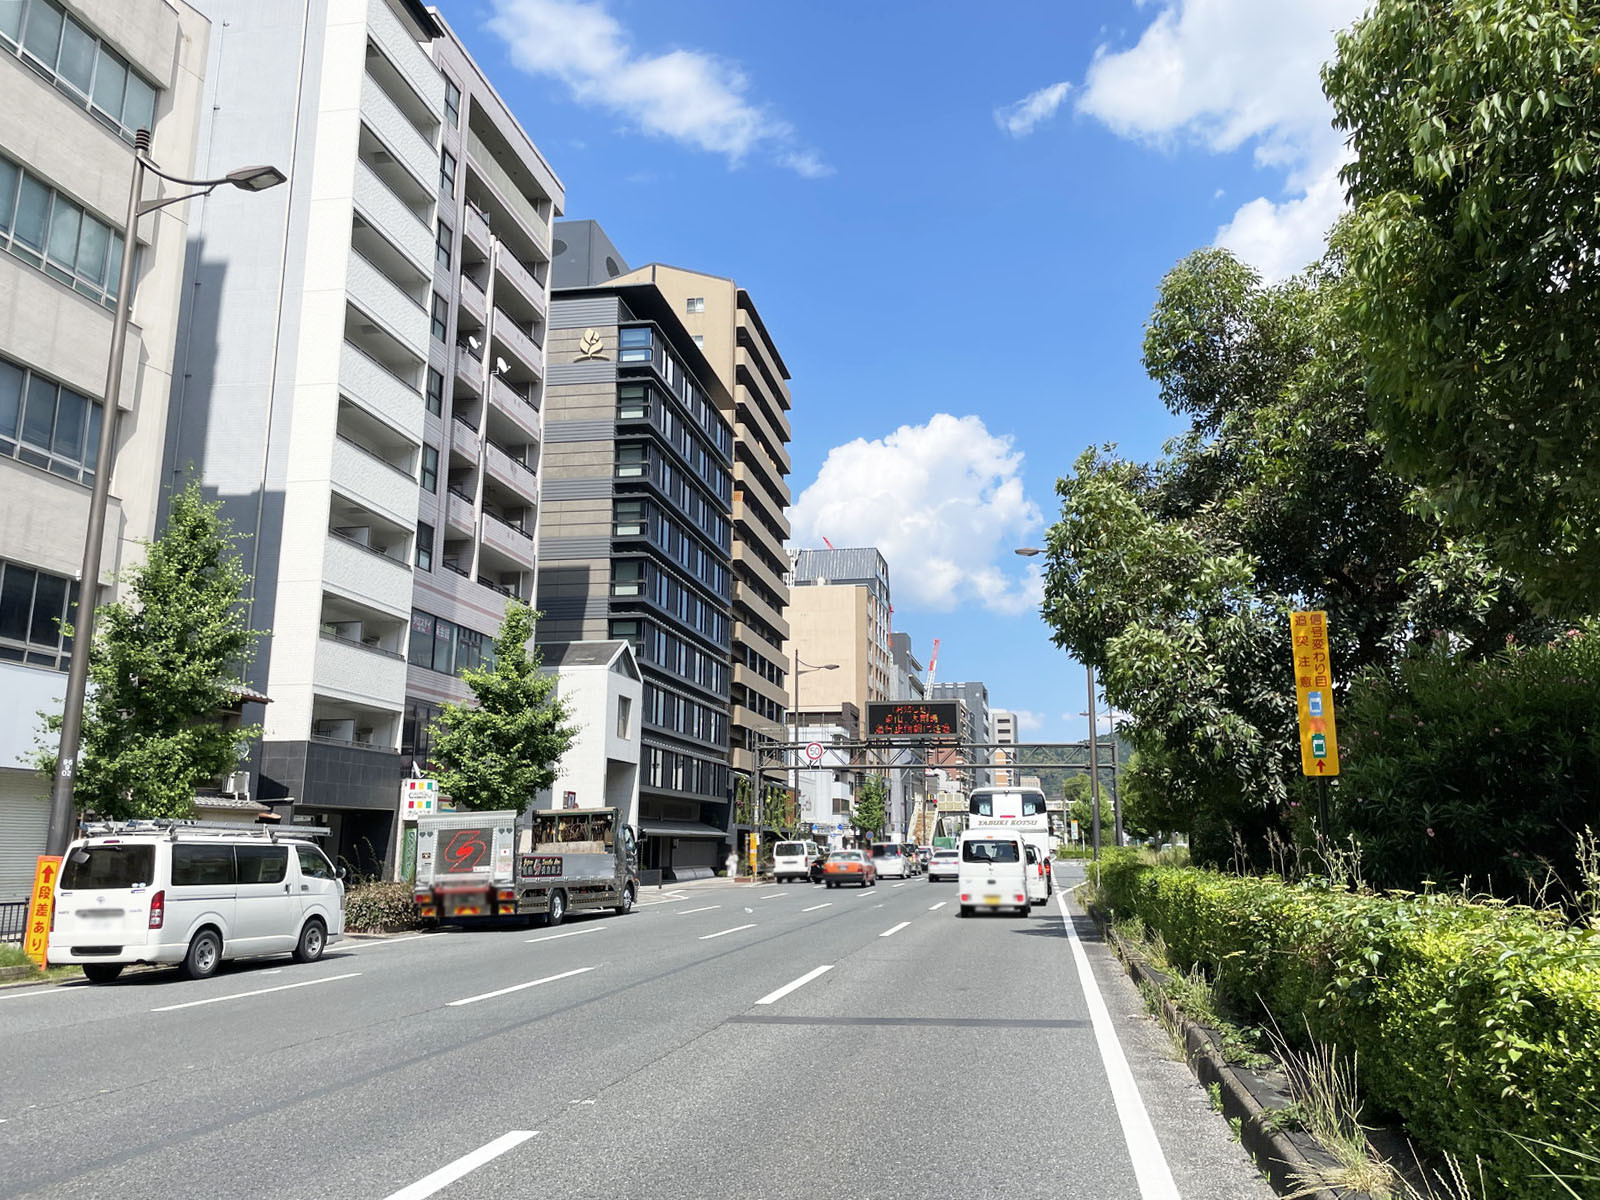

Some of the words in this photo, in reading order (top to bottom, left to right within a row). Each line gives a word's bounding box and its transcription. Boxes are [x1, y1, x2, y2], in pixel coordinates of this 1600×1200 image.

[1295, 615, 1312, 688] 追突注意
[1310, 614, 1328, 688] 信号変わり目
[809, 747, 820, 756] 50
[32, 885, 51, 951] 段差あり
